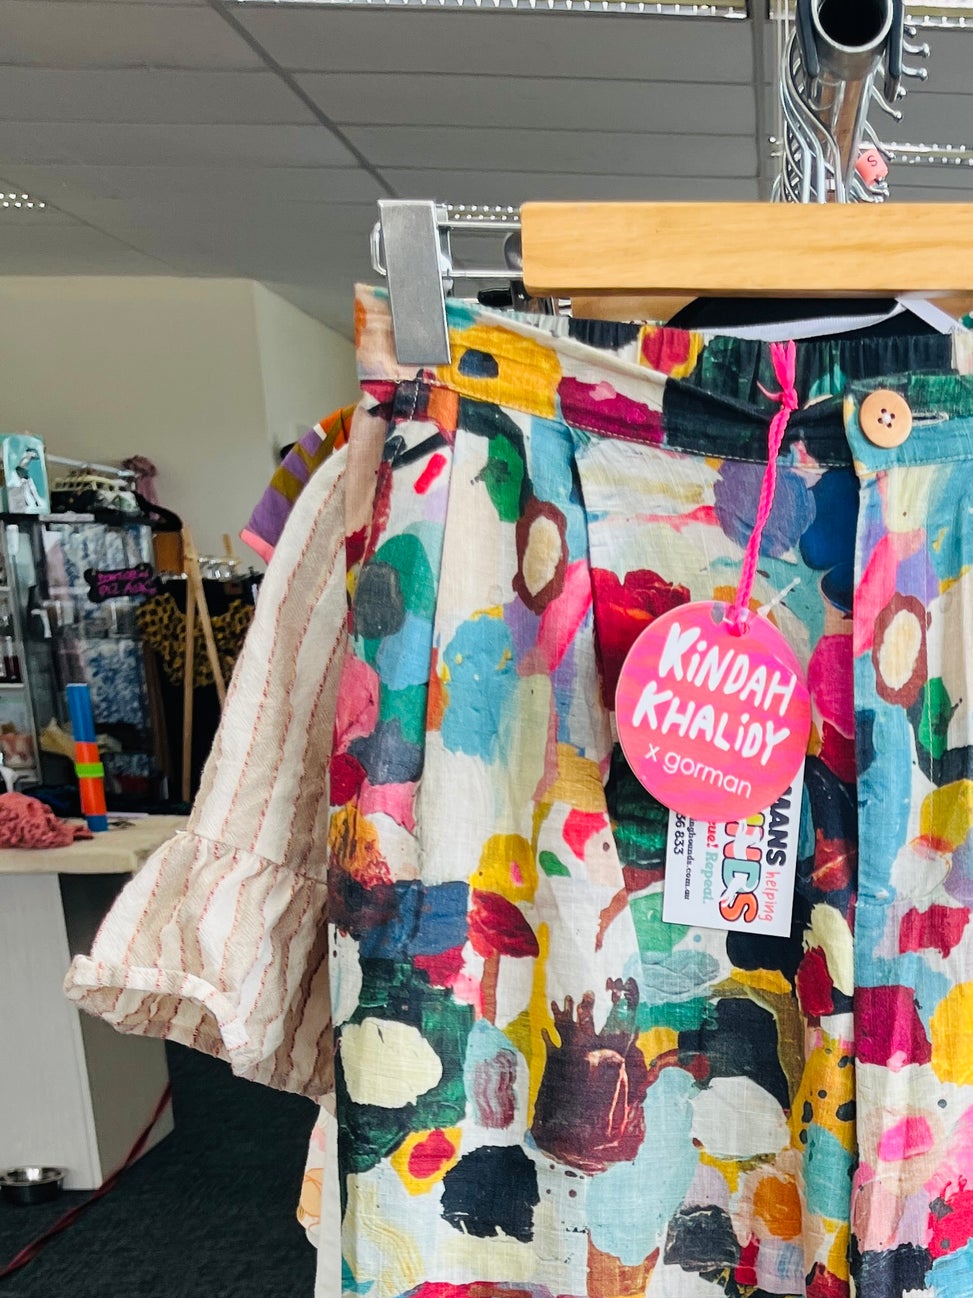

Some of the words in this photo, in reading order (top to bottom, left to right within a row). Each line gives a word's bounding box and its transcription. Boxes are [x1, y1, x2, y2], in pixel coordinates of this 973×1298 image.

[867, 155, 877, 166] S
[645, 743, 660, 762] x
[664, 751, 752, 798] gorman
[673, 830, 685, 856] 833
[759, 871, 780, 921] helping
